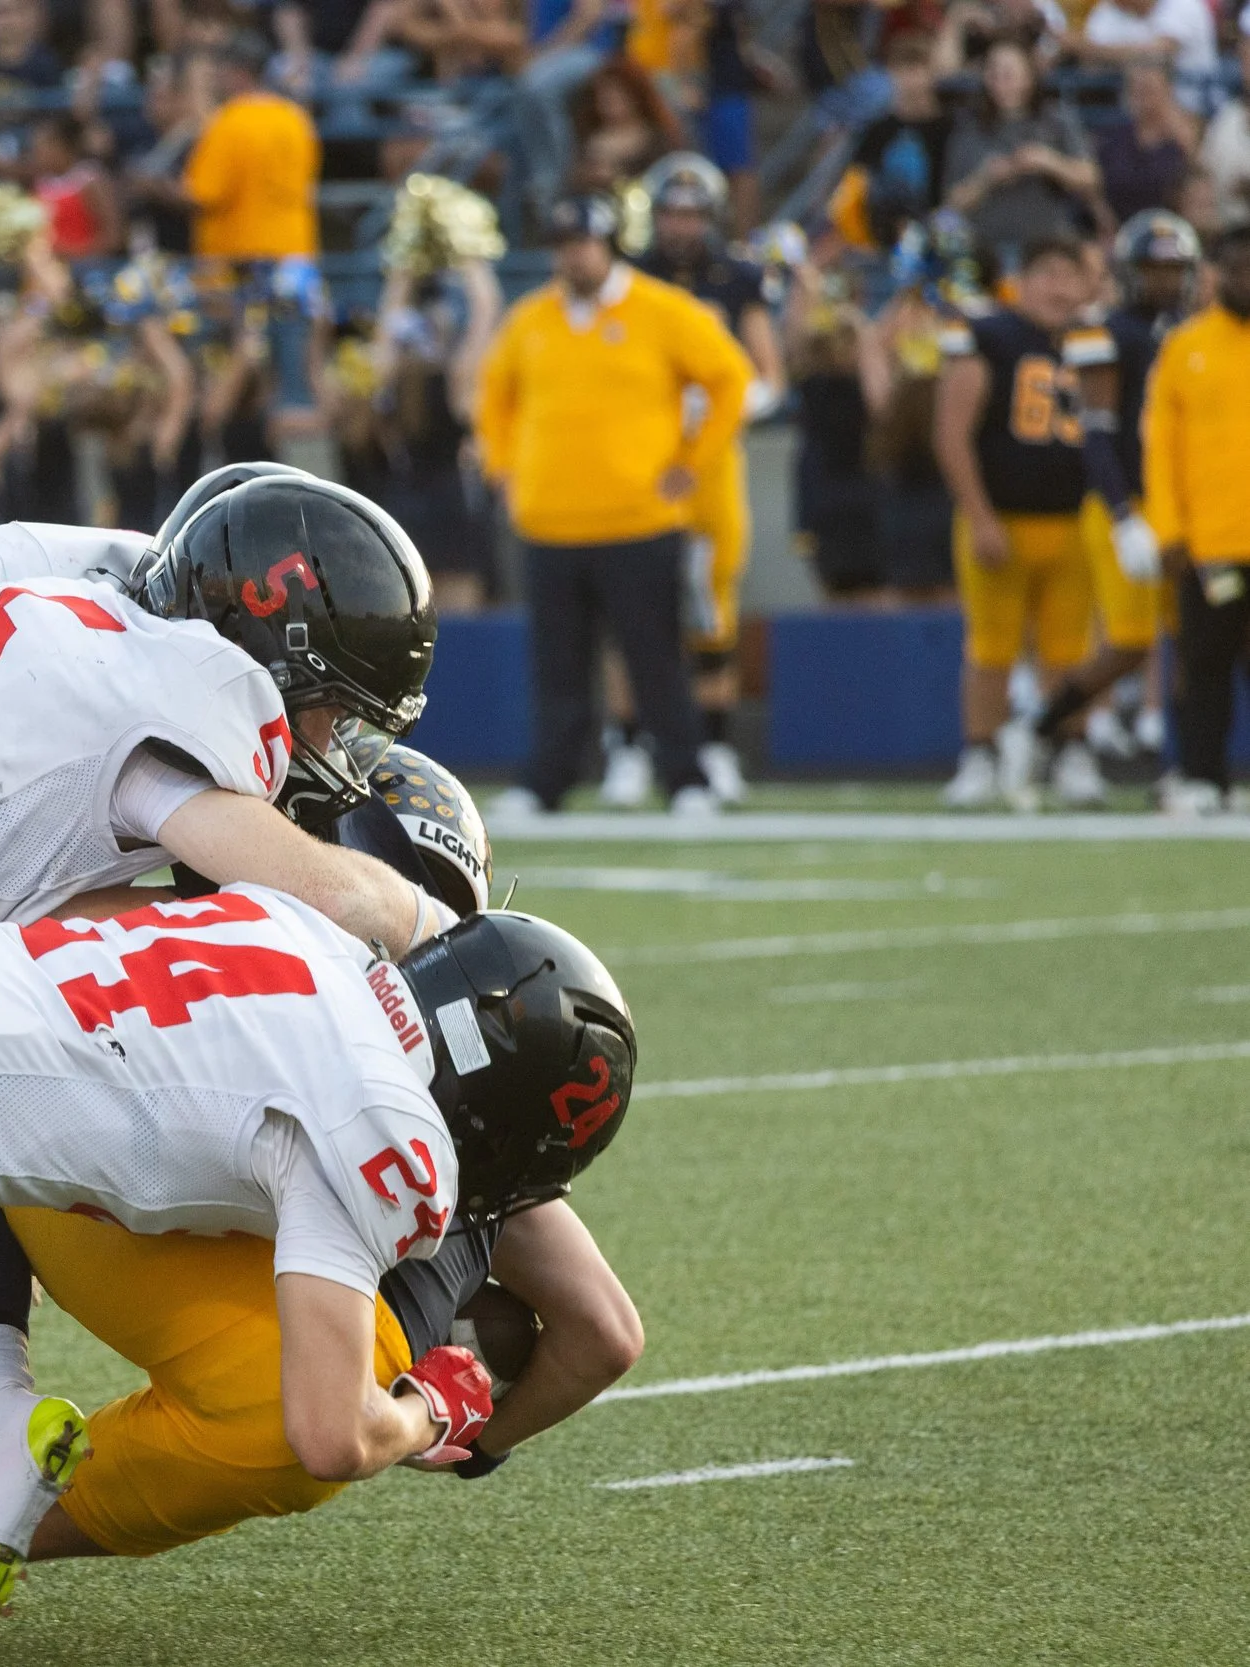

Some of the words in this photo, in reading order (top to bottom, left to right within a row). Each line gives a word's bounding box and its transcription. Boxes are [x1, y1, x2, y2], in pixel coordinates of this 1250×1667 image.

[241, 551, 319, 618] 5
[252, 712, 293, 793] 5
[418, 821, 482, 879] LIGHT
[549, 1055, 620, 1148] 24
[358, 1138, 448, 1260] 24
